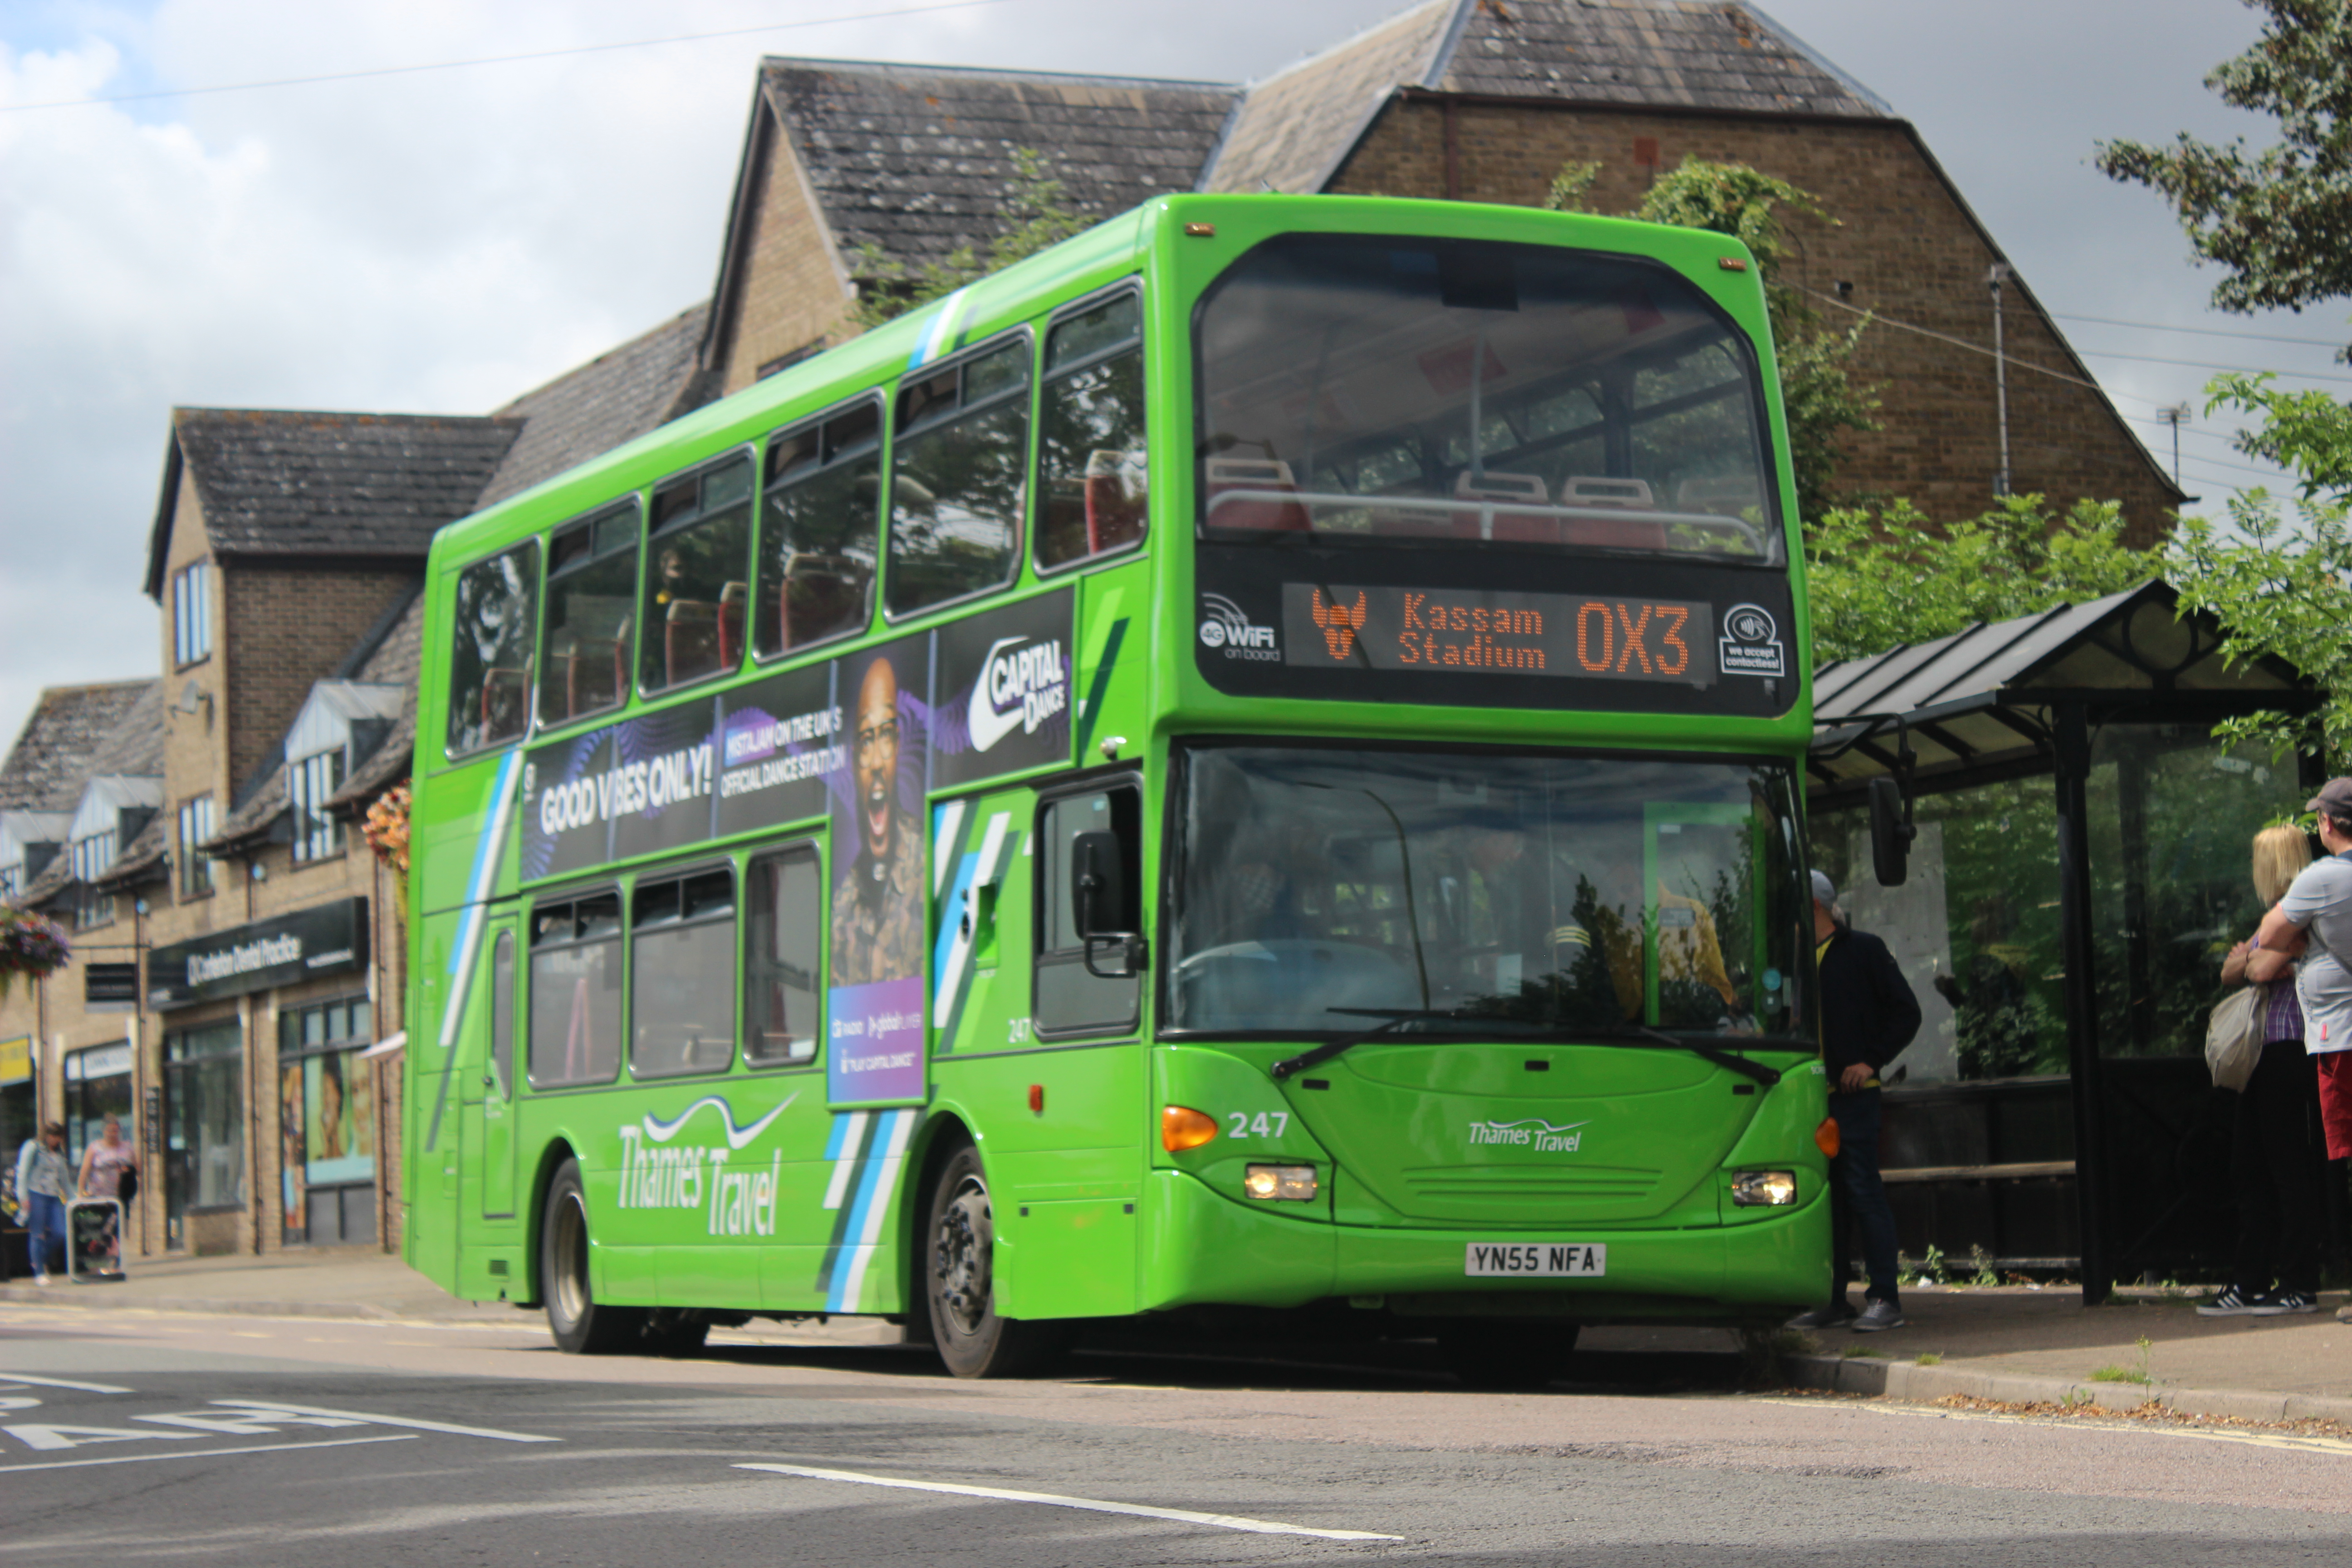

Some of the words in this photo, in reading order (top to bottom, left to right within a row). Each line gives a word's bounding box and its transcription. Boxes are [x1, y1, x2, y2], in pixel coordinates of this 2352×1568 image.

[1404, 592, 1543, 634] Kassam
[1225, 648, 1241, 659] on
[1244, 648, 1281, 662] board
[1226, 625, 1274, 648] WiFi
[1399, 631, 1545, 669] Stadium
[1577, 602, 1688, 675] OX3
[1728, 647, 1743, 656] we
[1744, 647, 1775, 659] accept
[991, 639, 1063, 705] CAPITAL
[1726, 657, 1779, 669] contactless!
[775, 720, 791, 747] ON
[791, 713, 814, 742] THE
[814, 706, 843, 737] UKS
[1024, 684, 1065, 735] DANCE
[540, 776, 598, 836] GOOD
[597, 760, 648, 821] VBES
[649, 743, 713, 808] ONLY!
[720, 766, 763, 799] OFFICIAL
[762, 756, 799, 788] DANCE
[798, 744, 846, 779] STATION
[1008, 1017, 1031, 1043] 247
[1228, 1112, 1289, 1138] 247
[1469, 1122, 1531, 1145] Thames
[1534, 1130, 1582, 1152] Travel
[618, 1125, 706, 1209] Thames
[708, 1147, 782, 1236] Travel
[1475, 1247, 1539, 1271] YN55
[1549, 1247, 1595, 1270] NFA
